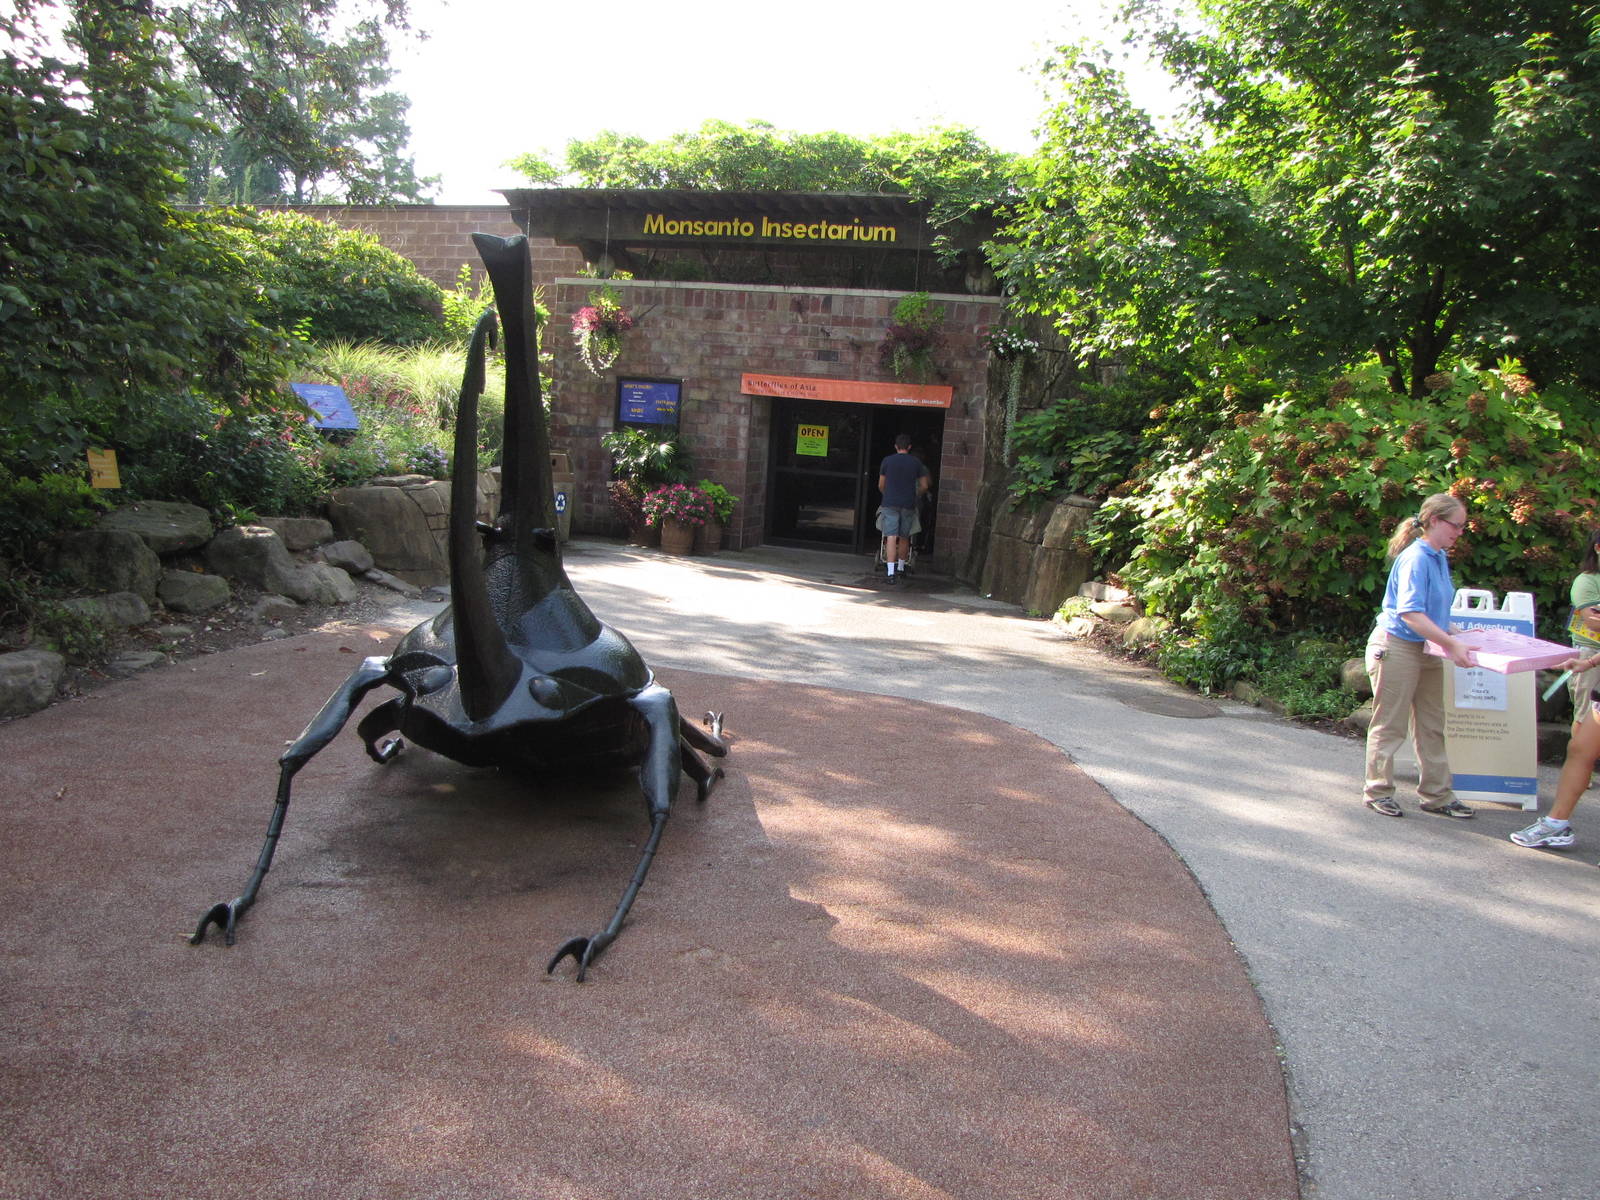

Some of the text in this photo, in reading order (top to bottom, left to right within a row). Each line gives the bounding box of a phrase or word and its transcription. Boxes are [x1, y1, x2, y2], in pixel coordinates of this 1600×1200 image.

[643, 214, 896, 242] Monsanto Insectarium
[747, 380, 788, 389] Butterflies
[800, 383, 817, 391] Asia
[801, 427, 825, 438] OPEN
[1467, 622, 1518, 633] Adventure
